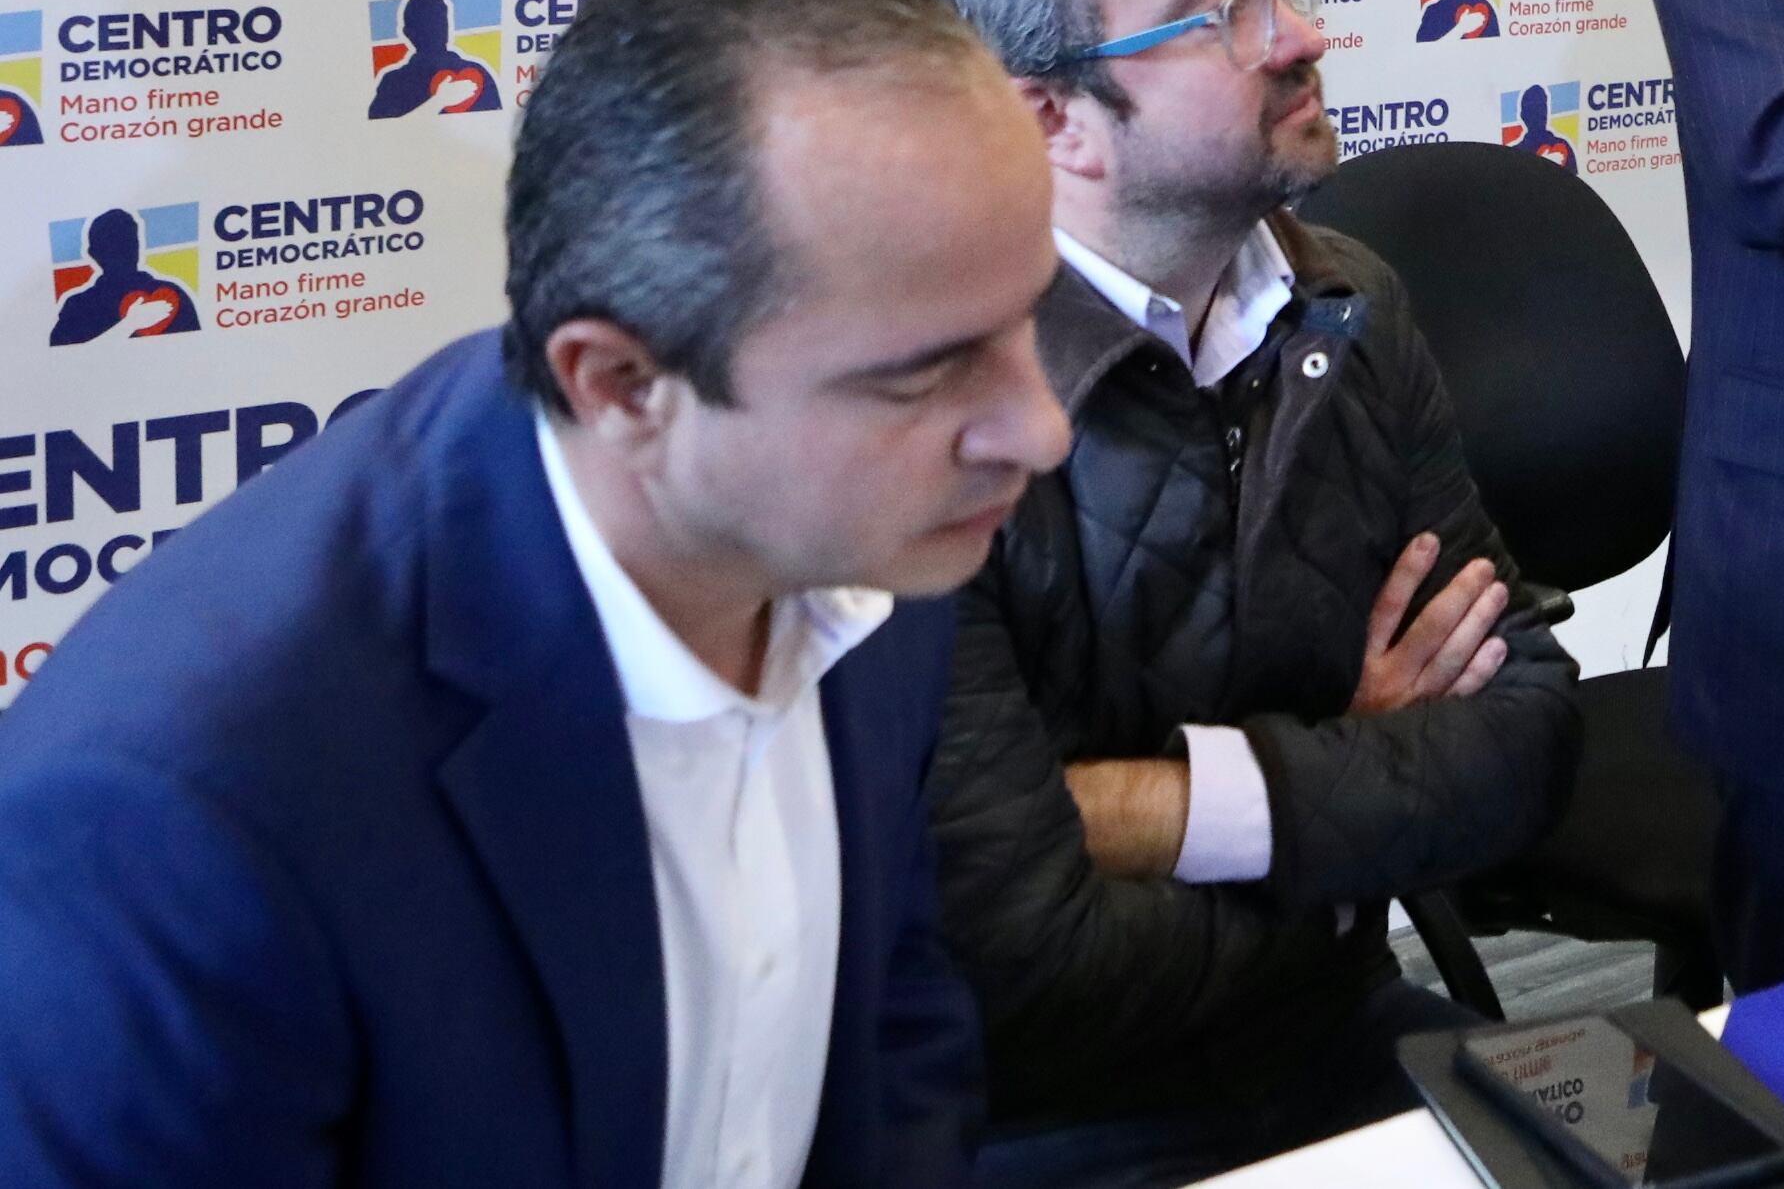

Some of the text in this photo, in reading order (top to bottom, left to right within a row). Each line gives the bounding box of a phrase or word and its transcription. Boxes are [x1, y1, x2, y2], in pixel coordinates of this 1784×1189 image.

[1509, 13, 1627, 37] Corazón grande
[1510, 1, 1550, 16] Mano
[58, 6, 282, 54] CENTRO
[60, 49, 282, 83] DEMOCRÁTICO
[61, 89, 219, 115] Mano firme
[61, 108, 282, 143] Corazón grande
[213, 189, 424, 242] CENTRO
[216, 231, 424, 271] DEMOCRÁTICO
[217, 272, 365, 302] Mano firme
[216, 287, 424, 328] Corazón grande
[0, 388, 391, 530] ENTR
